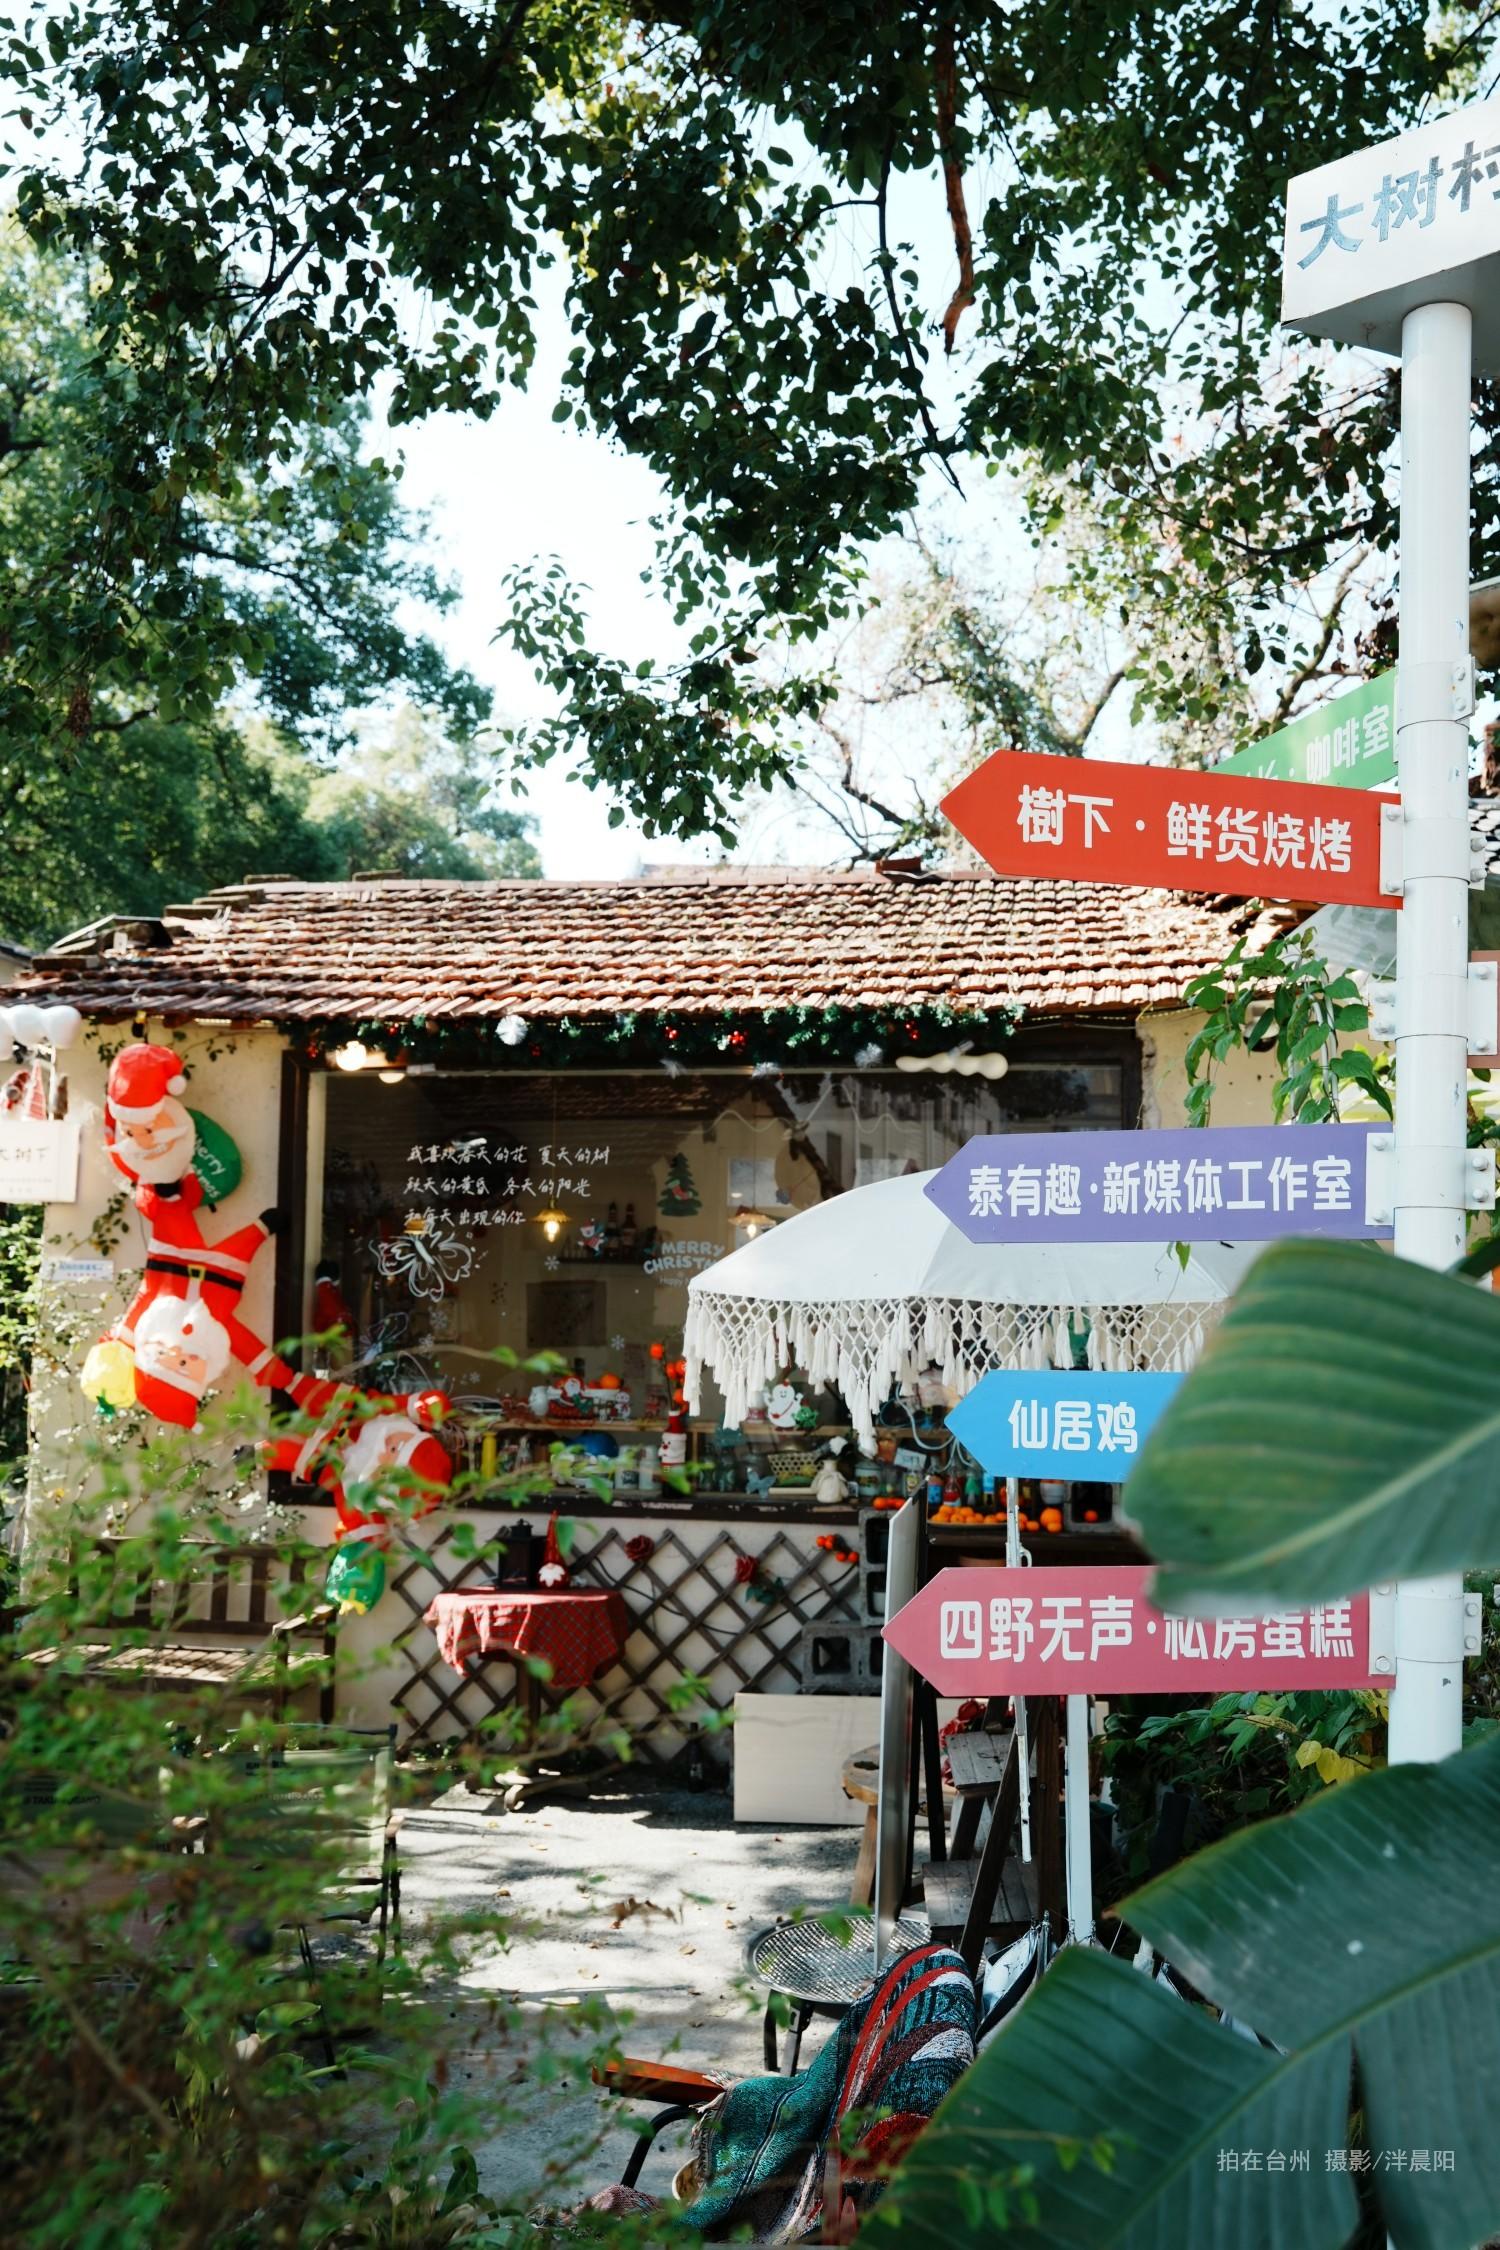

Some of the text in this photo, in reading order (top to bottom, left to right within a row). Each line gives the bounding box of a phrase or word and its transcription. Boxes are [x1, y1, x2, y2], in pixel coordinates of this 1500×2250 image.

[538, 1144, 610, 1167] 夏天的树
[402, 1175, 592, 1199] 秋天的黄昏 冬天的阳光
[968, 1155, 1352, 1217] 泰有趣·新媒体工作室
[1008, 1399, 1139, 1454] 仙居鸡
